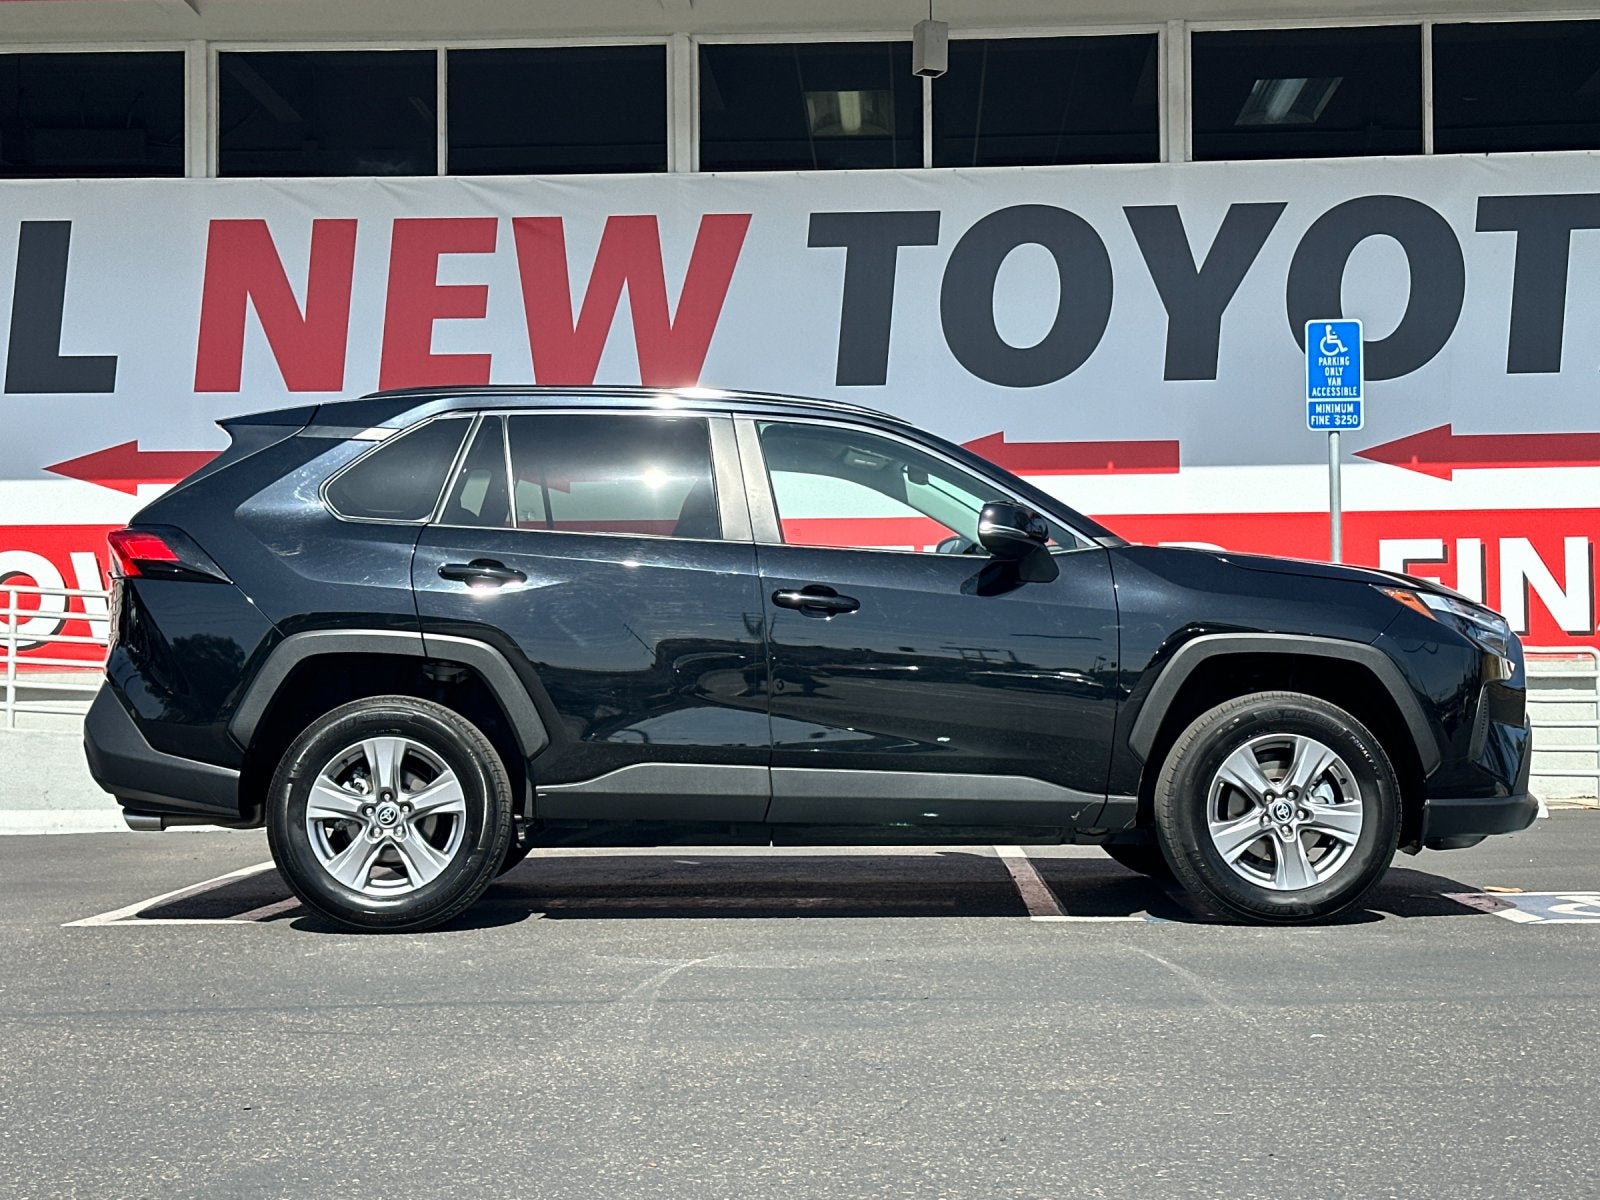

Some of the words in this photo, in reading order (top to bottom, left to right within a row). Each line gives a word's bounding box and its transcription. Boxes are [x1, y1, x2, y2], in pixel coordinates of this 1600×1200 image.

[193, 213, 752, 392] NEW
[1318, 356, 1350, 367] PARKING
[1324, 367, 1344, 376] ONLY
[1327, 377, 1342, 386] VAN
[1311, 387, 1358, 396] ACCESSIBLE
[1315, 403, 1354, 413] MINIMUM
[1310, 415, 1331, 426] FINE
[1334, 415, 1358, 426] $250
